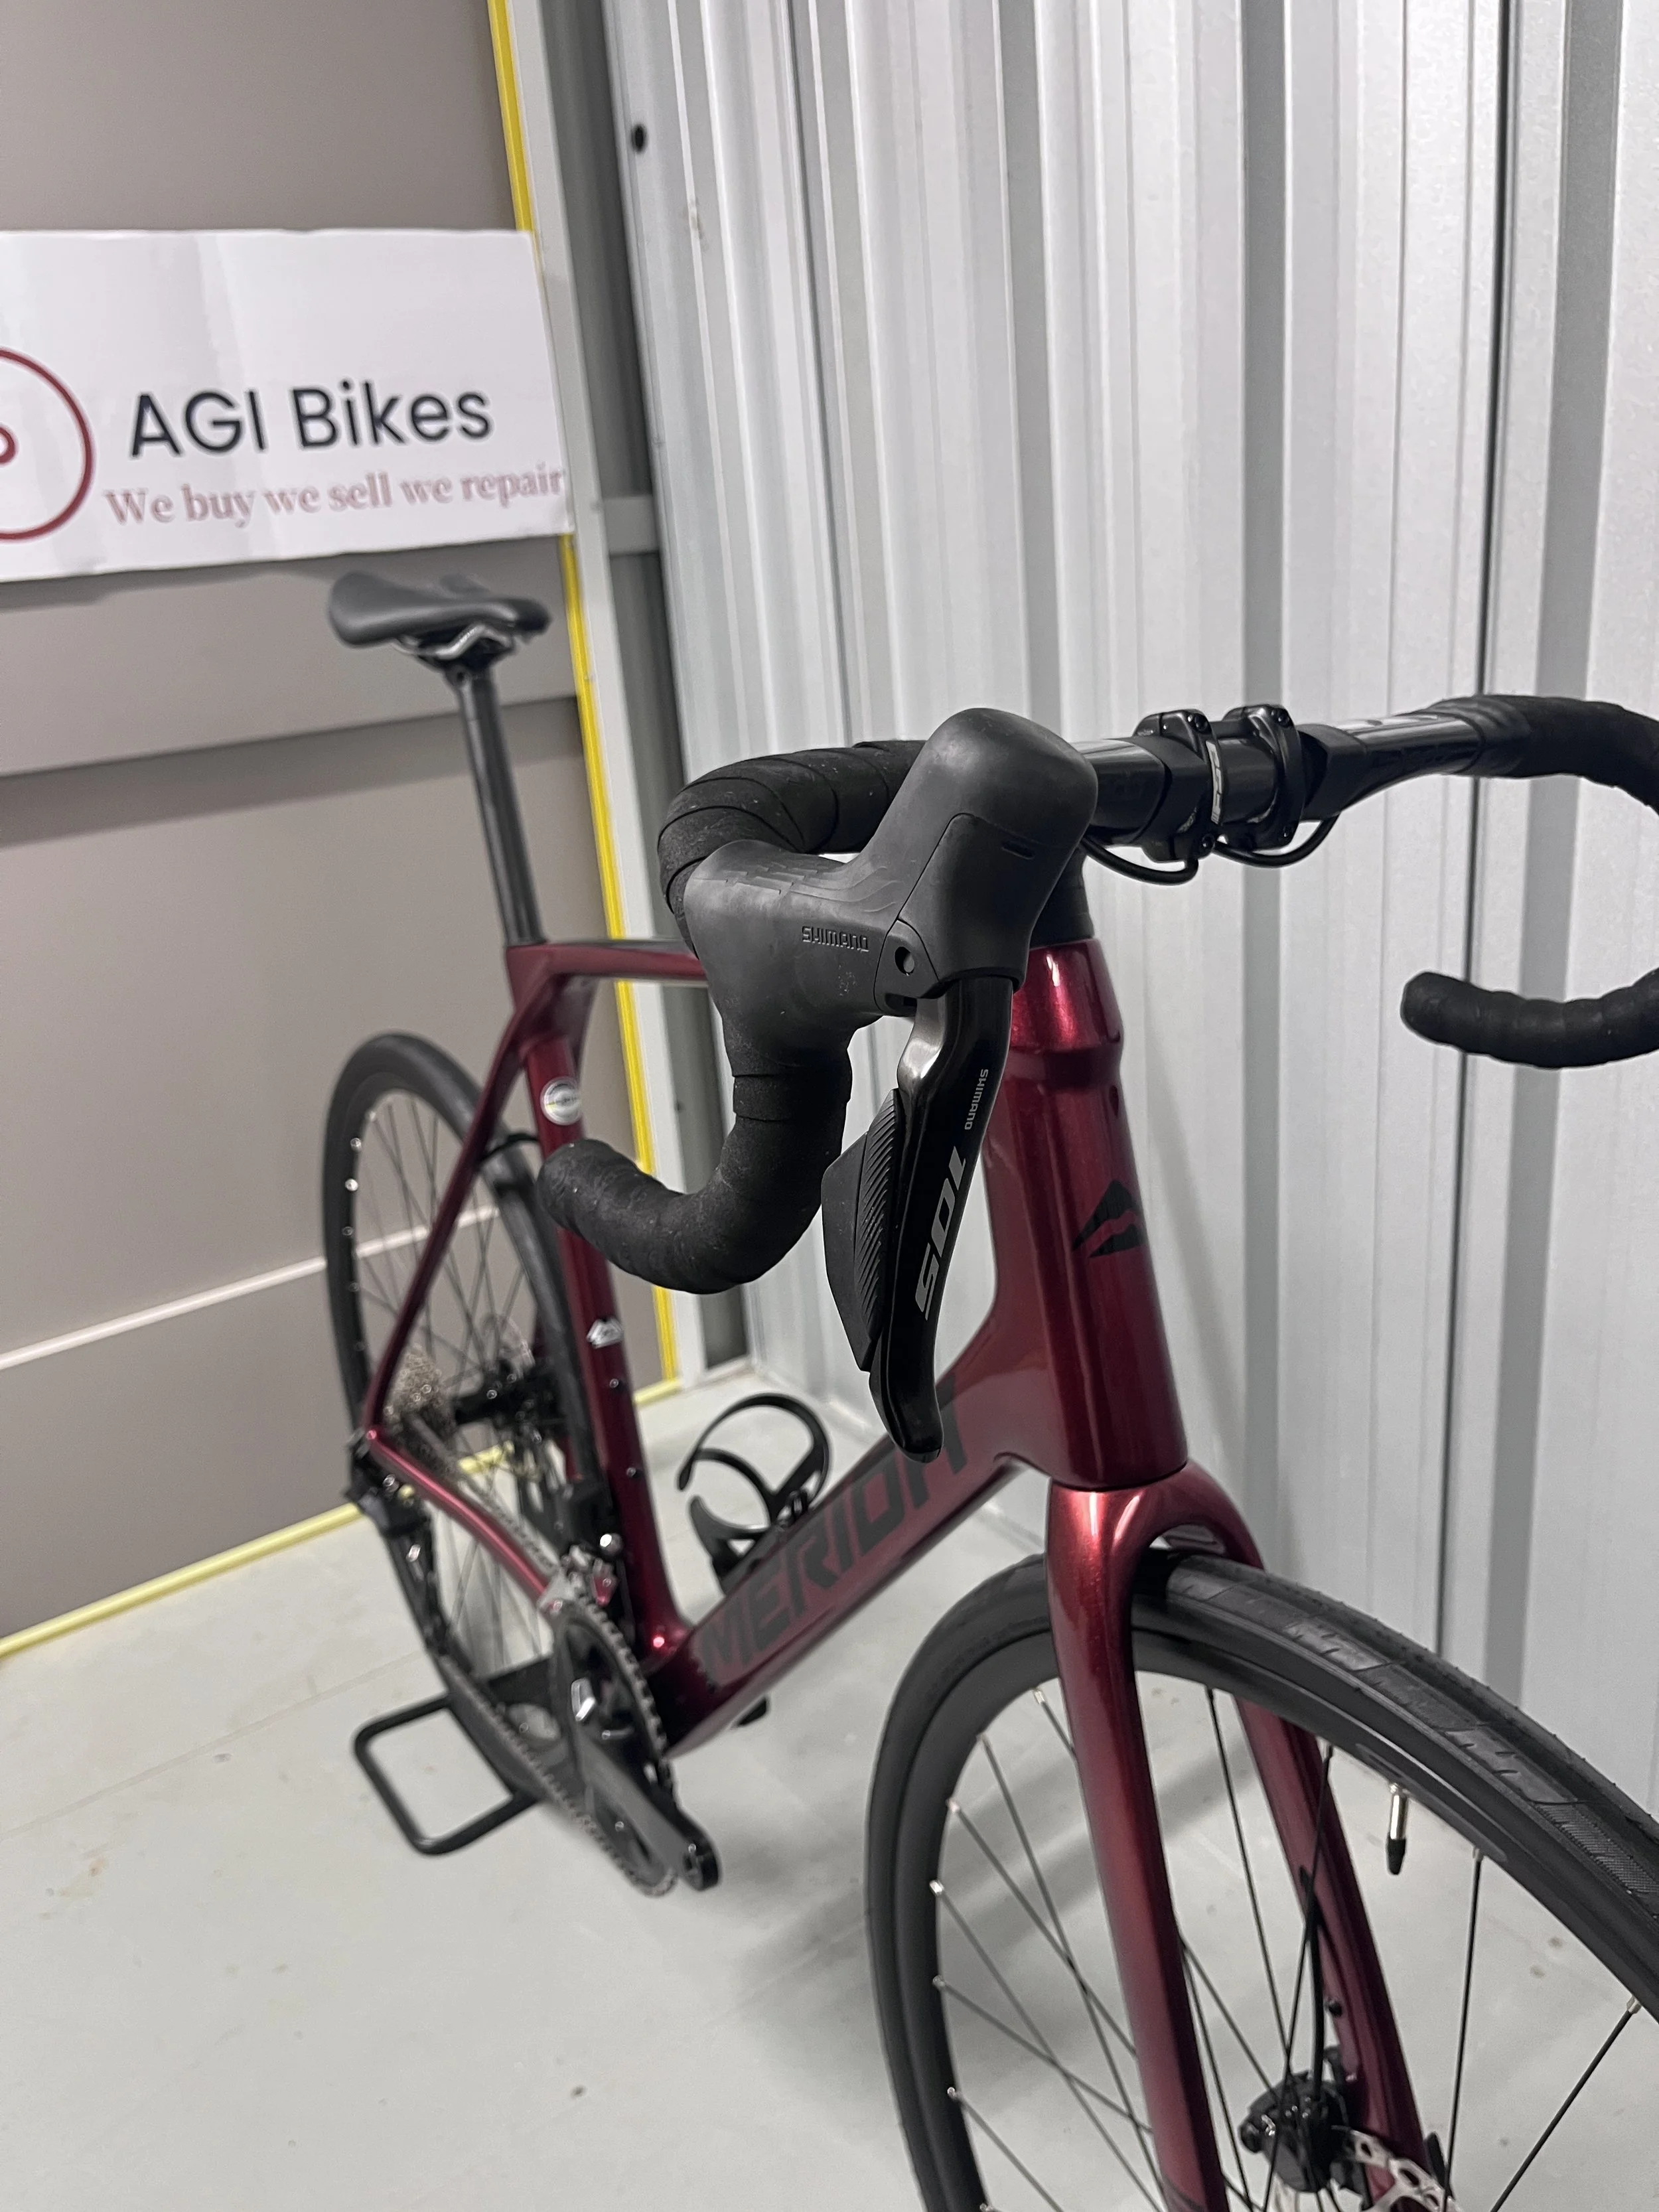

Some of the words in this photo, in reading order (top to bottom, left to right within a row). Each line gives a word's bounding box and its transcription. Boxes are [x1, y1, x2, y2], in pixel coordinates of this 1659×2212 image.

[129, 388, 268, 459] AGI
[291, 377, 494, 449] Bikes
[104, 486, 175, 526] We
[182, 482, 256, 528] buy
[263, 486, 321, 515] we
[328, 471, 392, 510] sell
[399, 475, 453, 504] we
[460, 462, 566, 507] repair
[964, 1069, 989, 1130] SHIMANO
[915, 1146, 966, 1321] 105
